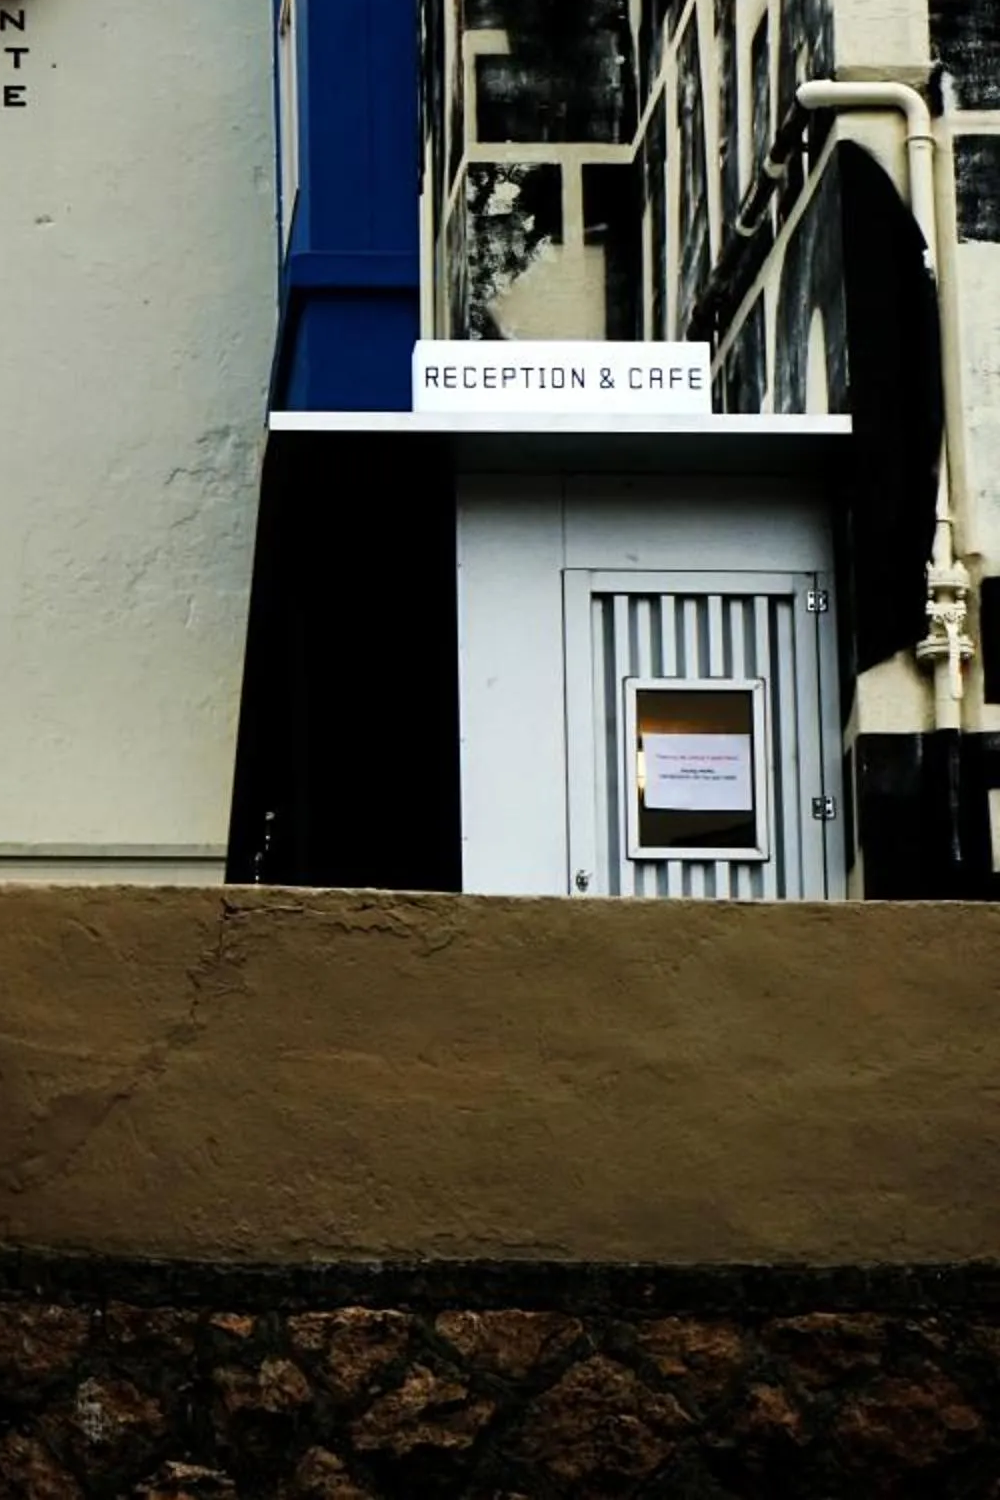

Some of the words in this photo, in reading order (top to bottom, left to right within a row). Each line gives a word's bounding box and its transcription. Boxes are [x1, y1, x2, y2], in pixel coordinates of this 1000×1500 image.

[425, 366, 586, 389] RECEPTION
[599, 367, 615, 389] &
[629, 368, 703, 390] CAFE
